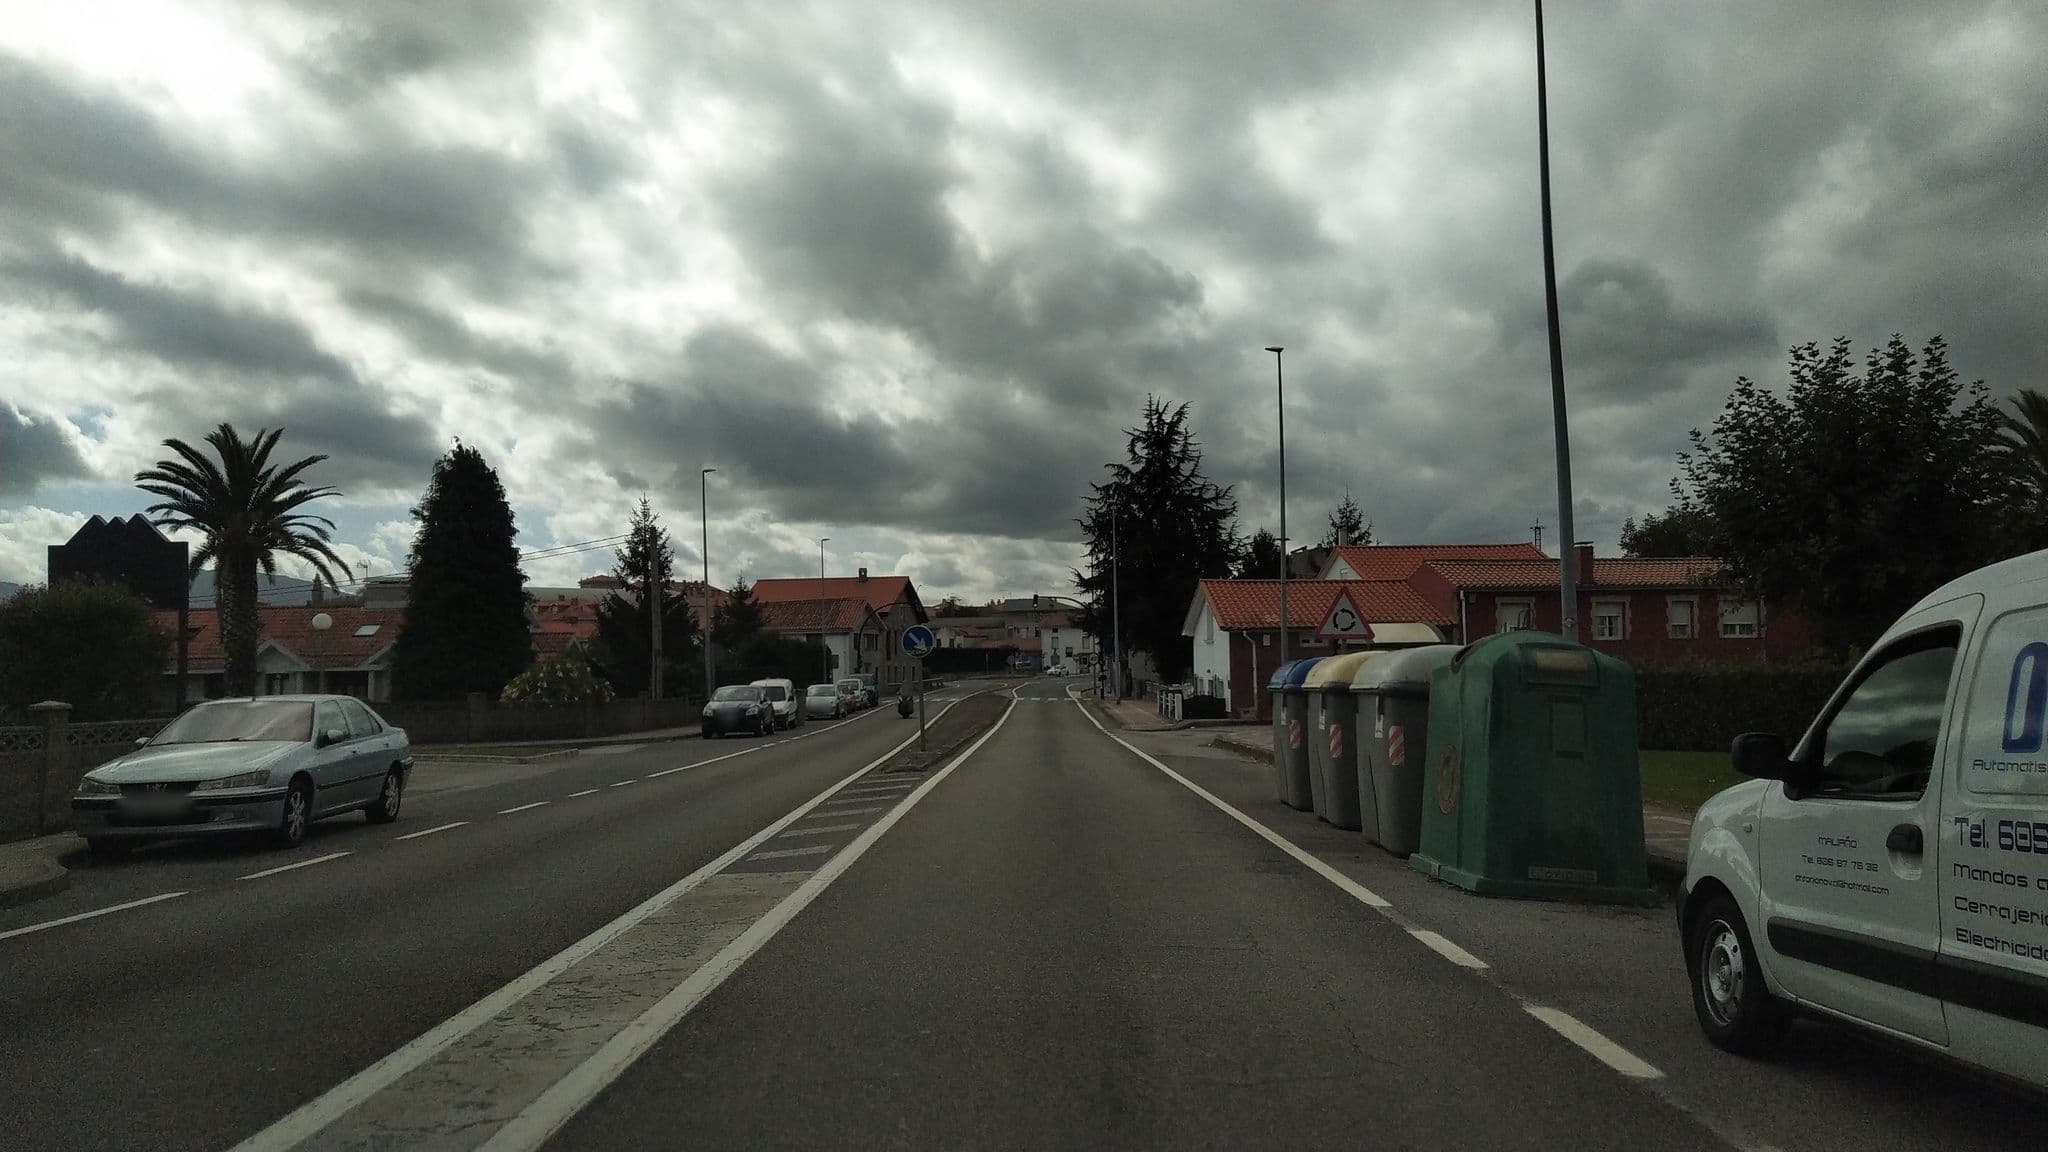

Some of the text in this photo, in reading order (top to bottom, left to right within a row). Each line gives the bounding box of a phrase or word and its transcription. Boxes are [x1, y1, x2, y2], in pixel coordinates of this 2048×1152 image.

[1972, 759, 2048, 773] Automatis
[1954, 816, 1989, 849] Tel.
[1953, 862, 2028, 888] Mandos
